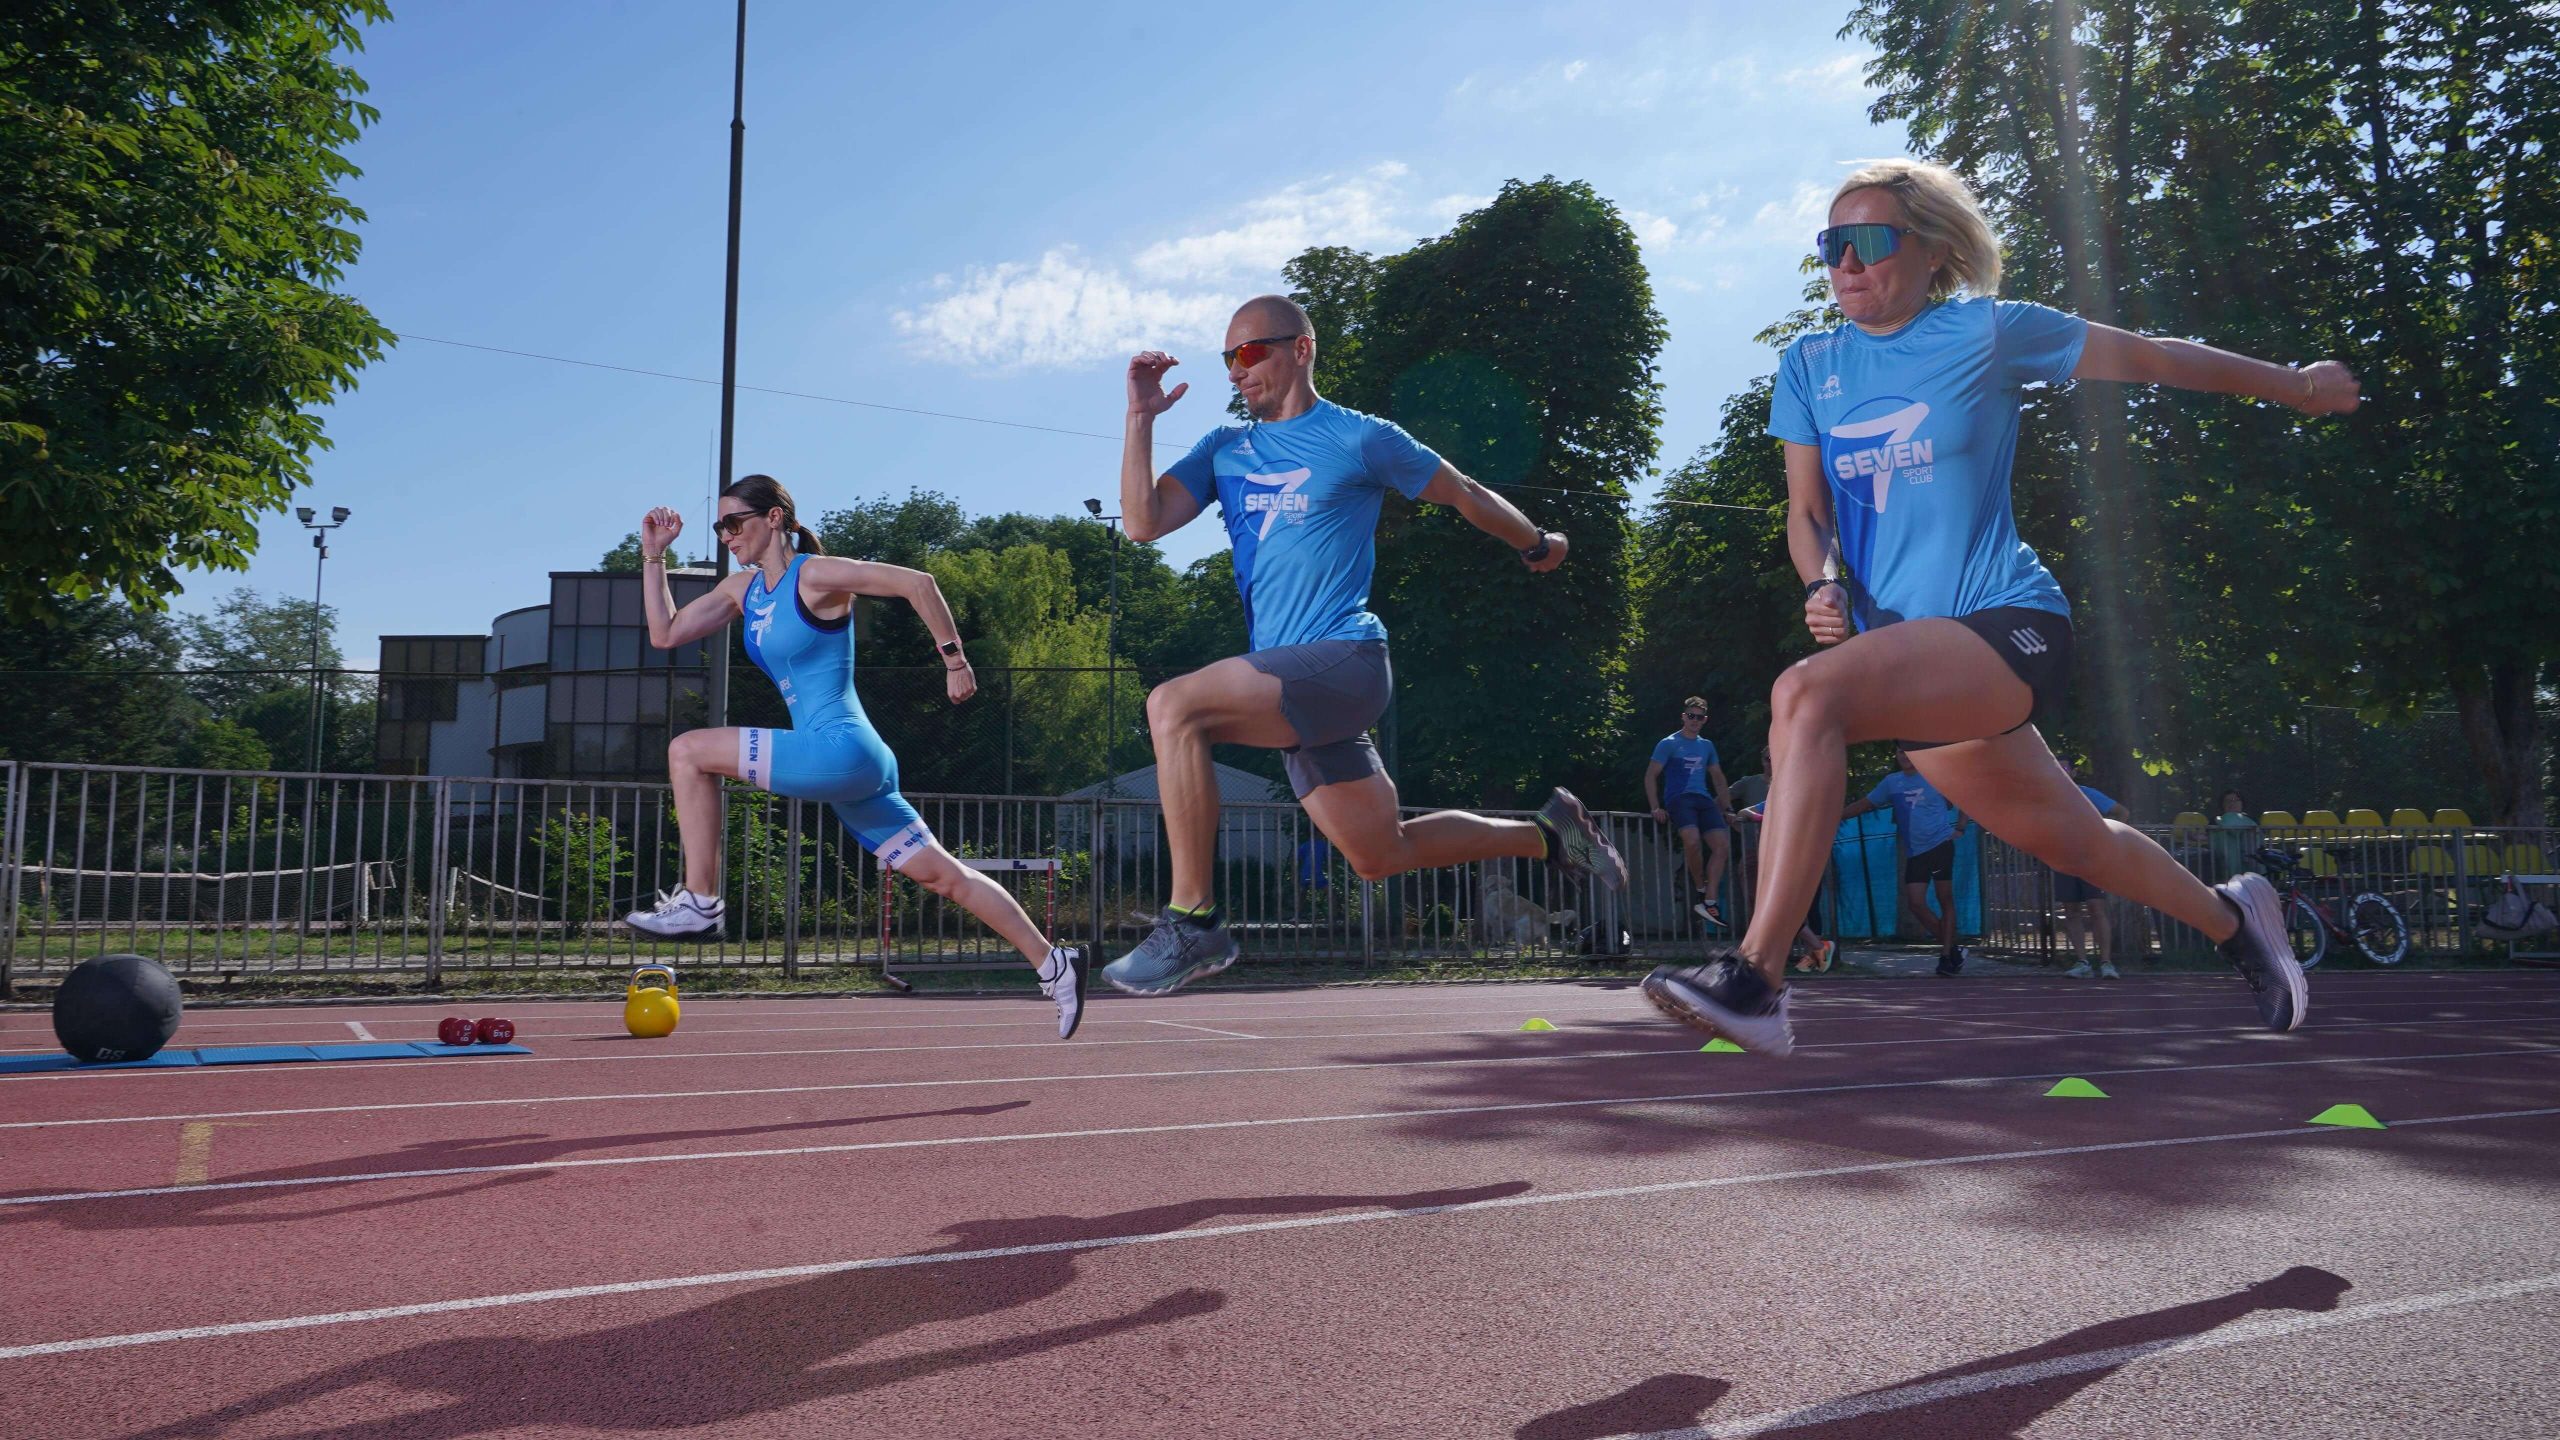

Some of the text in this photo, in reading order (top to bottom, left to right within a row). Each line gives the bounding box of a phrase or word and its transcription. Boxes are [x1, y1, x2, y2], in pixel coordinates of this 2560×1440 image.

[1834, 438, 1934, 481] SEVEN
[1902, 466, 1934, 478] SPORT
[1909, 474, 1934, 485] CLUB
[1244, 493, 1309, 513] SEVEN
[749, 728, 759, 762] SEVEN
[748, 769, 757, 784] SE
[884, 849, 902, 865] VEN
